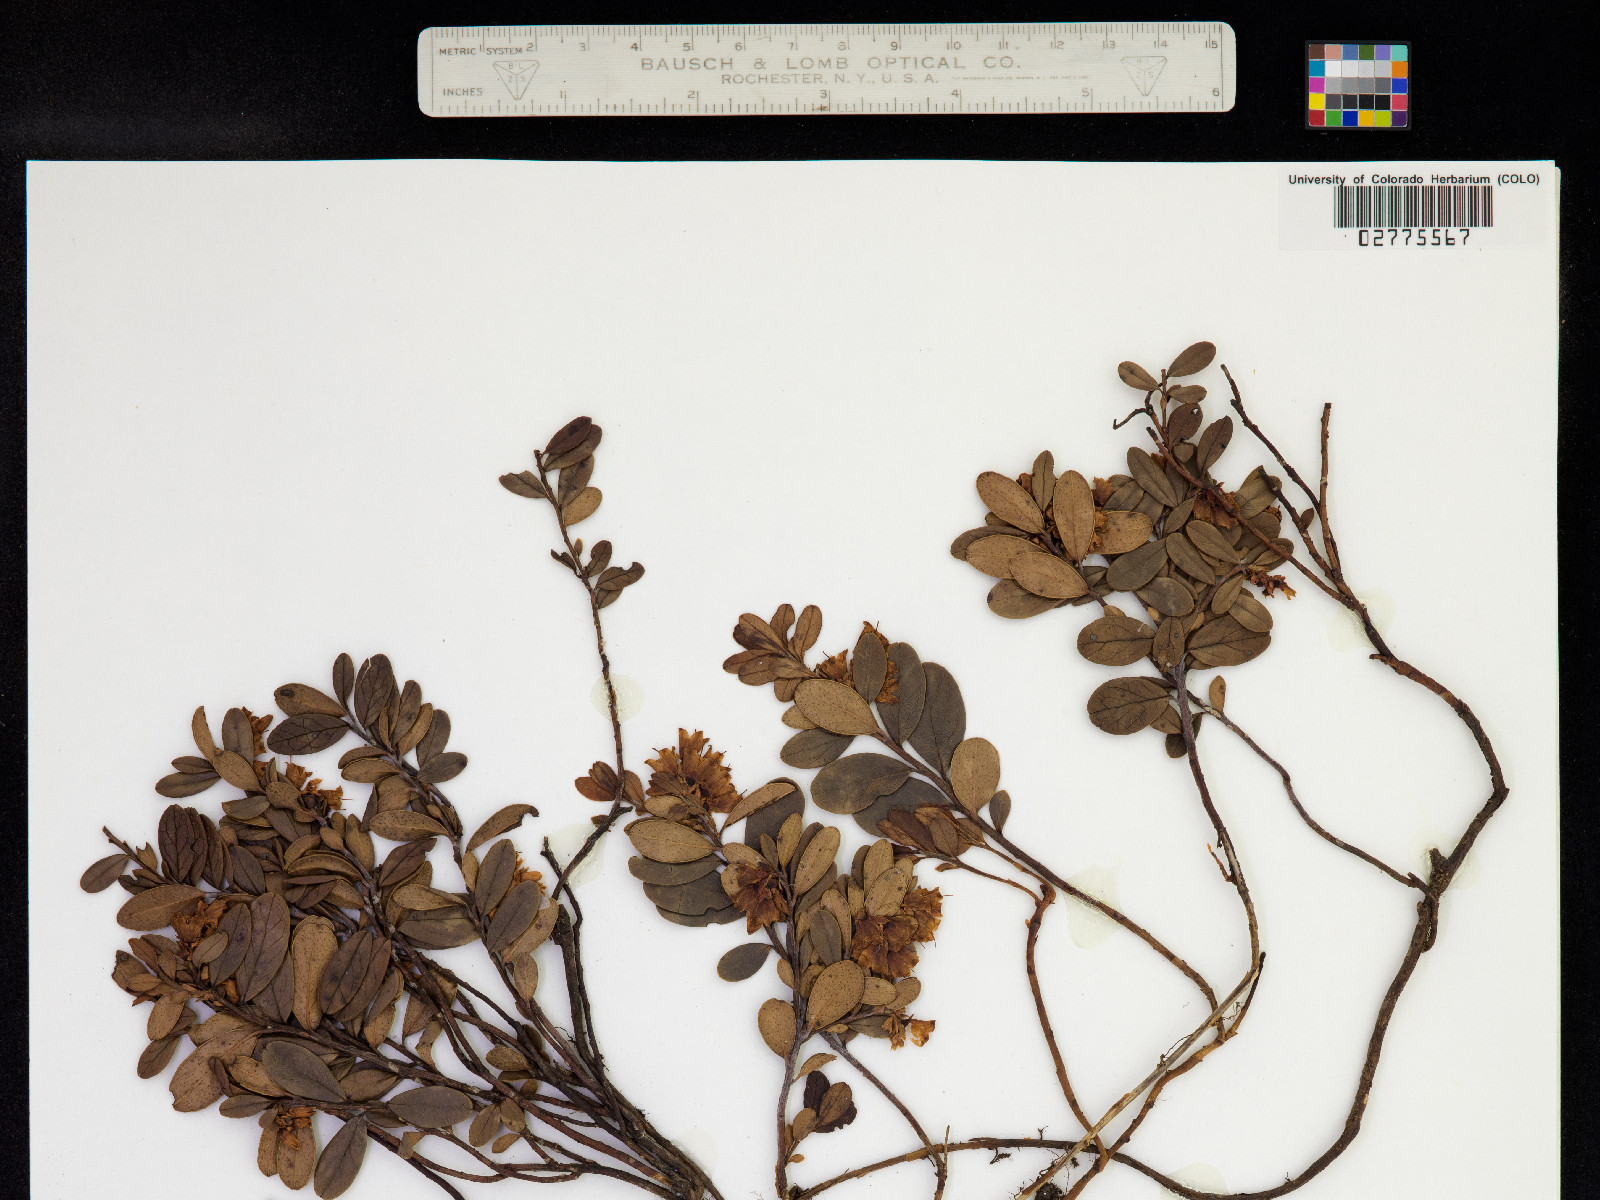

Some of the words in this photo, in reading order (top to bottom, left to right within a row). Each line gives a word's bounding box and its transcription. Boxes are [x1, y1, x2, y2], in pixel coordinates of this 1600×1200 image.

[439, 47, 477, 56] METRIC
[486, 47, 523, 55] SYSTEM
[526, 43, 534, 51] 2
[579, 43, 586, 51] 3
[631, 43, 639, 51] 4
[683, 42, 691, 51] 5
[735, 42, 742, 51] 6
[787, 42, 794, 50] 7
[838, 42, 846, 50] 8
[891, 42, 898, 50] 9
[641, 57, 733, 70] BAUSCH
[754, 57, 766, 69] &
[787, 57, 849, 69] LOMB
[867, 56, 965, 69] OPTICAL
[983, 56, 1021, 68] CO.
[721, 74, 828, 85] ROCHESTER,
[443, 88, 483, 96] INCHES
[687, 90, 695, 98] 2
[820, 89, 827, 98] 3
[951, 89, 959, 97] 4
[1082, 88, 1090, 97] 5
[1212, 87, 1220, 96] 6
[1288, 174, 1346, 186] University
[1353, 174, 1365, 184] of
[1371, 174, 1424, 184] Colorado
[1431, 174, 1491, 184] Herbarium
[1497, 174, 1540, 186] (COLO)
[1358, 229, 1470, 247] 02775567
